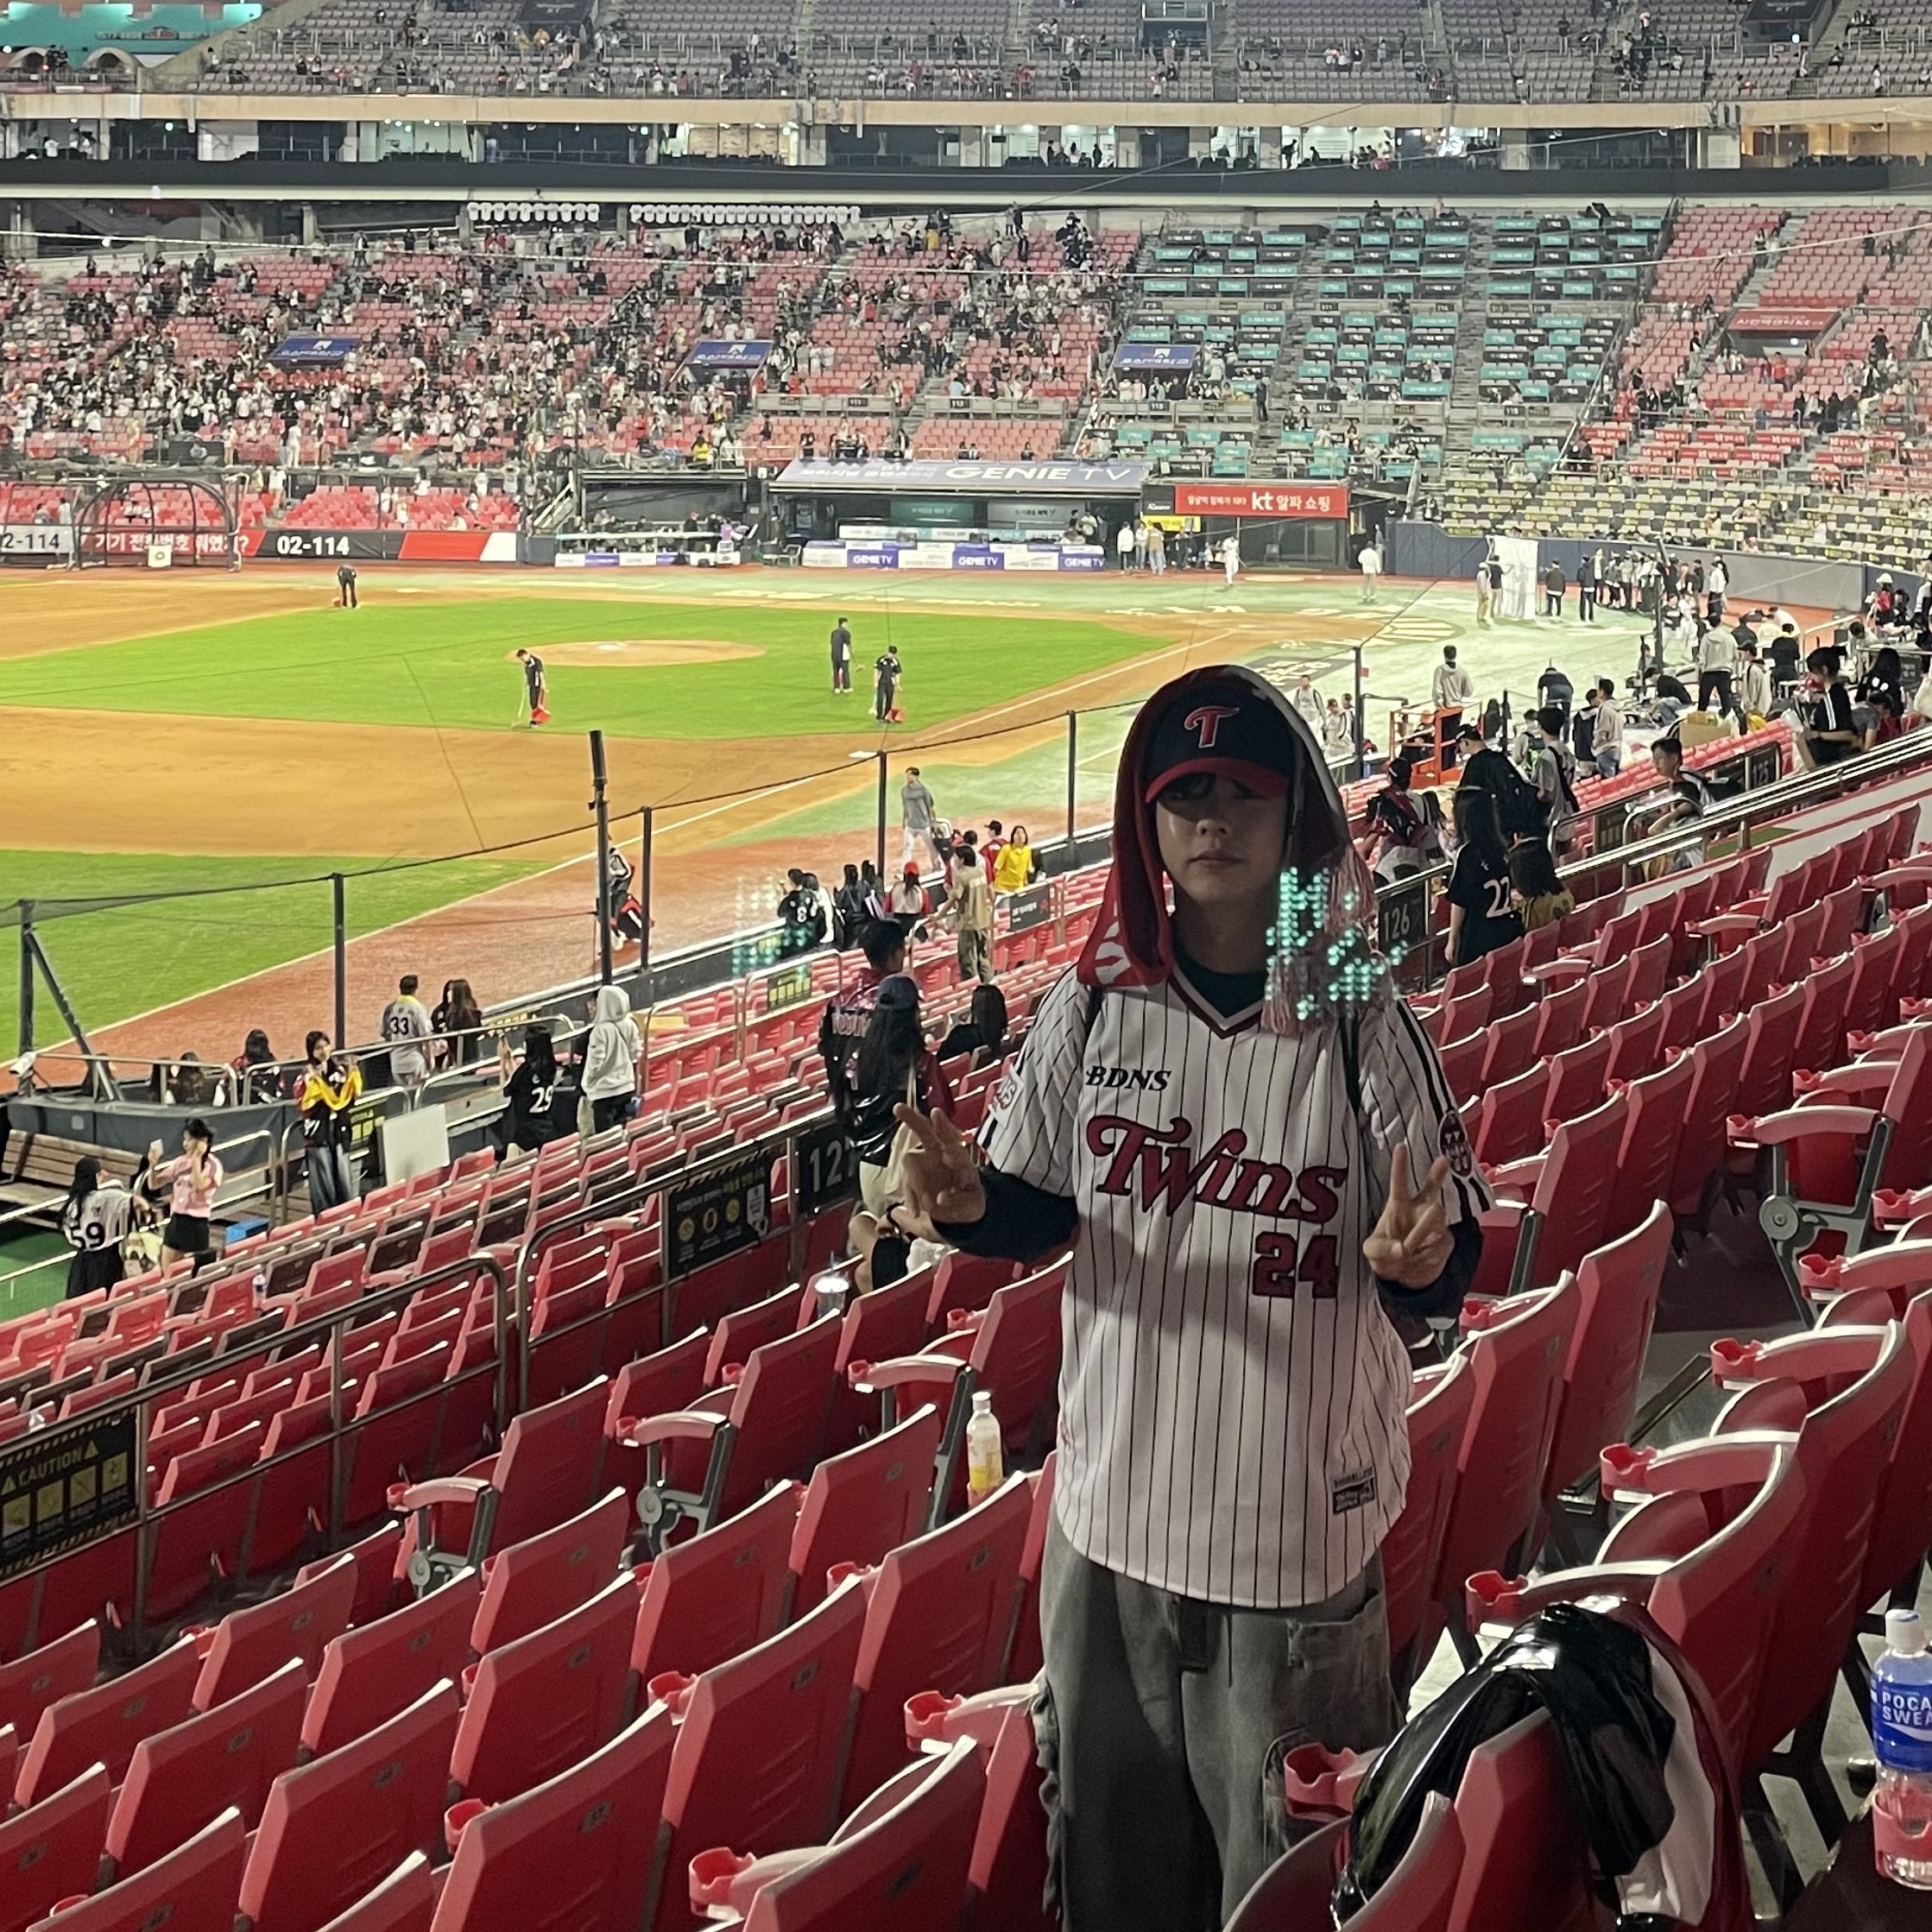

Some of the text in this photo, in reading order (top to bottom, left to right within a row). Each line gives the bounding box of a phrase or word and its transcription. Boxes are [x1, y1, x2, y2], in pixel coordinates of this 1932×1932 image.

[945, 467, 1069, 480] GENIE
[1081, 468, 1132, 481] TV
[1252, 492, 1273, 511] kt
[1277, 495, 1302, 511] 알파
[1304, 495, 1330, 512] 쇼핑
[276, 535, 350, 555] 02-114
[1184, 705, 1240, 748] T
[1384, 903, 1410, 942] 126
[389, 1016, 409, 1035] 33
[1085, 1065, 1172, 1091] BDNS
[529, 1084, 554, 1114] 29
[1086, 1114, 1349, 1224] Twins
[69, 1222, 105, 1249] 59
[1253, 1231, 1339, 1298] 24
[18, 1446, 83, 1487] CAUTION
[1882, 1691, 1932, 1712] POCA
